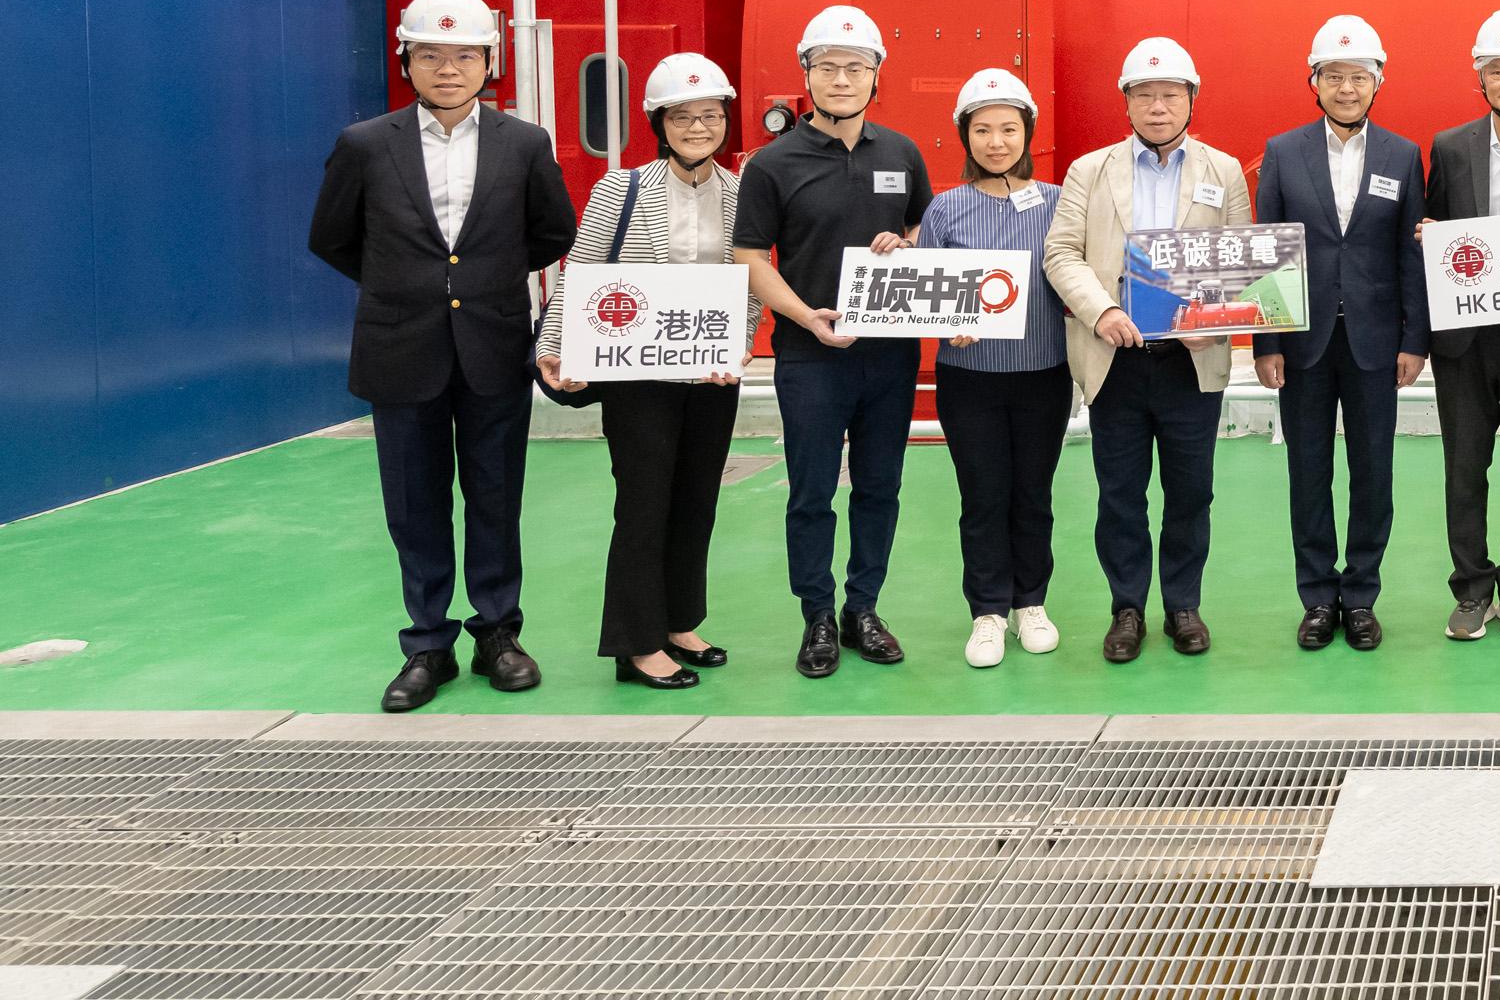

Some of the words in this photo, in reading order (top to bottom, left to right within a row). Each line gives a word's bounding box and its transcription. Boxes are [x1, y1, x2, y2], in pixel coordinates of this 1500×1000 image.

[1148, 234, 1278, 270] 低碳發電
[845, 265, 868, 323] 香港邁向
[866, 266, 1018, 314] 碳中和
[1456, 293, 1488, 316] HK
[654, 309, 730, 341] 港燈
[861, 313, 904, 325] Carbon
[907, 314, 979, 327] Neutral@HK
[595, 346, 633, 367] HK
[640, 344, 729, 366] Electric
